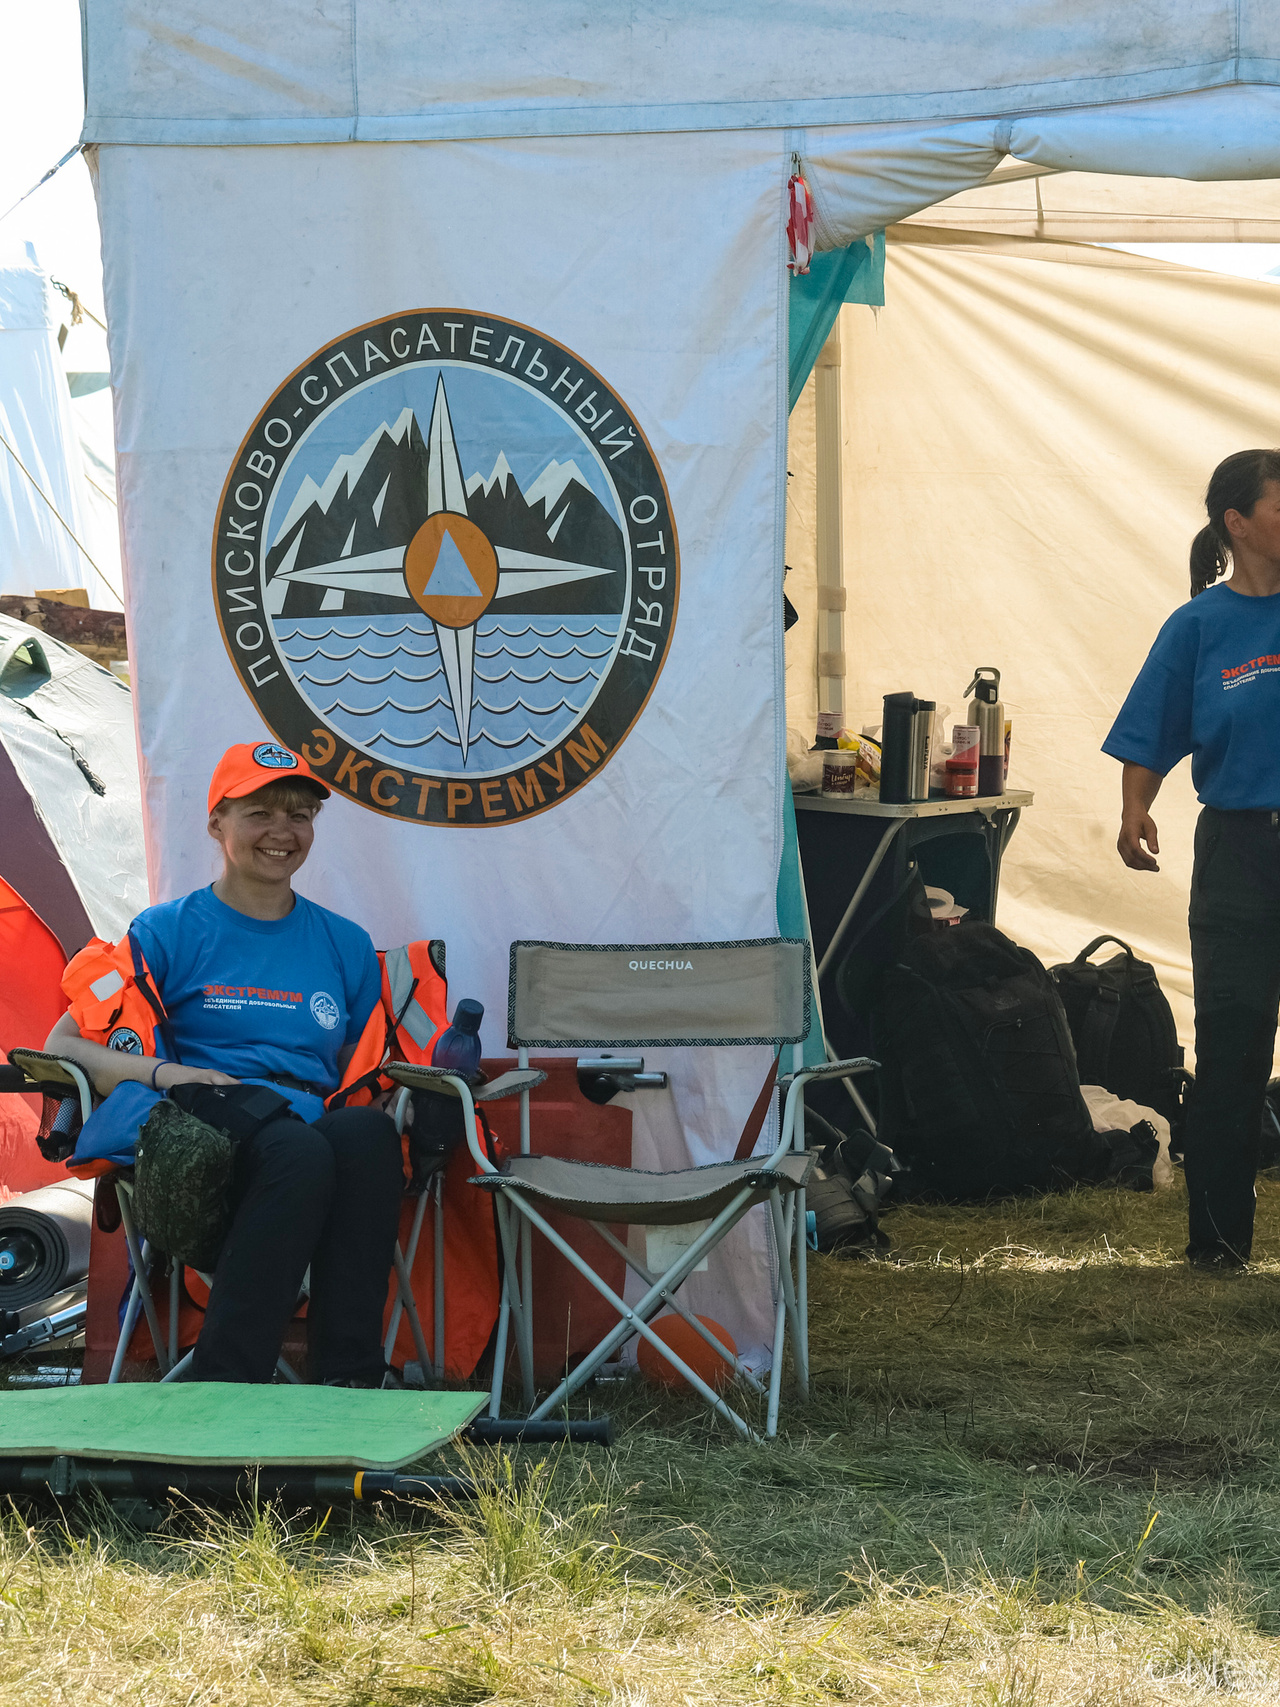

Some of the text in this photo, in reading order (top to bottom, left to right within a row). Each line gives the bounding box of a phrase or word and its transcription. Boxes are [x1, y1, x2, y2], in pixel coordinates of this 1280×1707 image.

[225, 321, 667, 688] ПОИСКОВО-СПАСАТЕЛЬНЫЙ ОТРЯД
[301, 722, 609, 819] ЭКСТРЕМУМ
[203, 984, 303, 1003] ЭКСТРЕМУМ
[628, 960, 694, 971] QUECHUA
